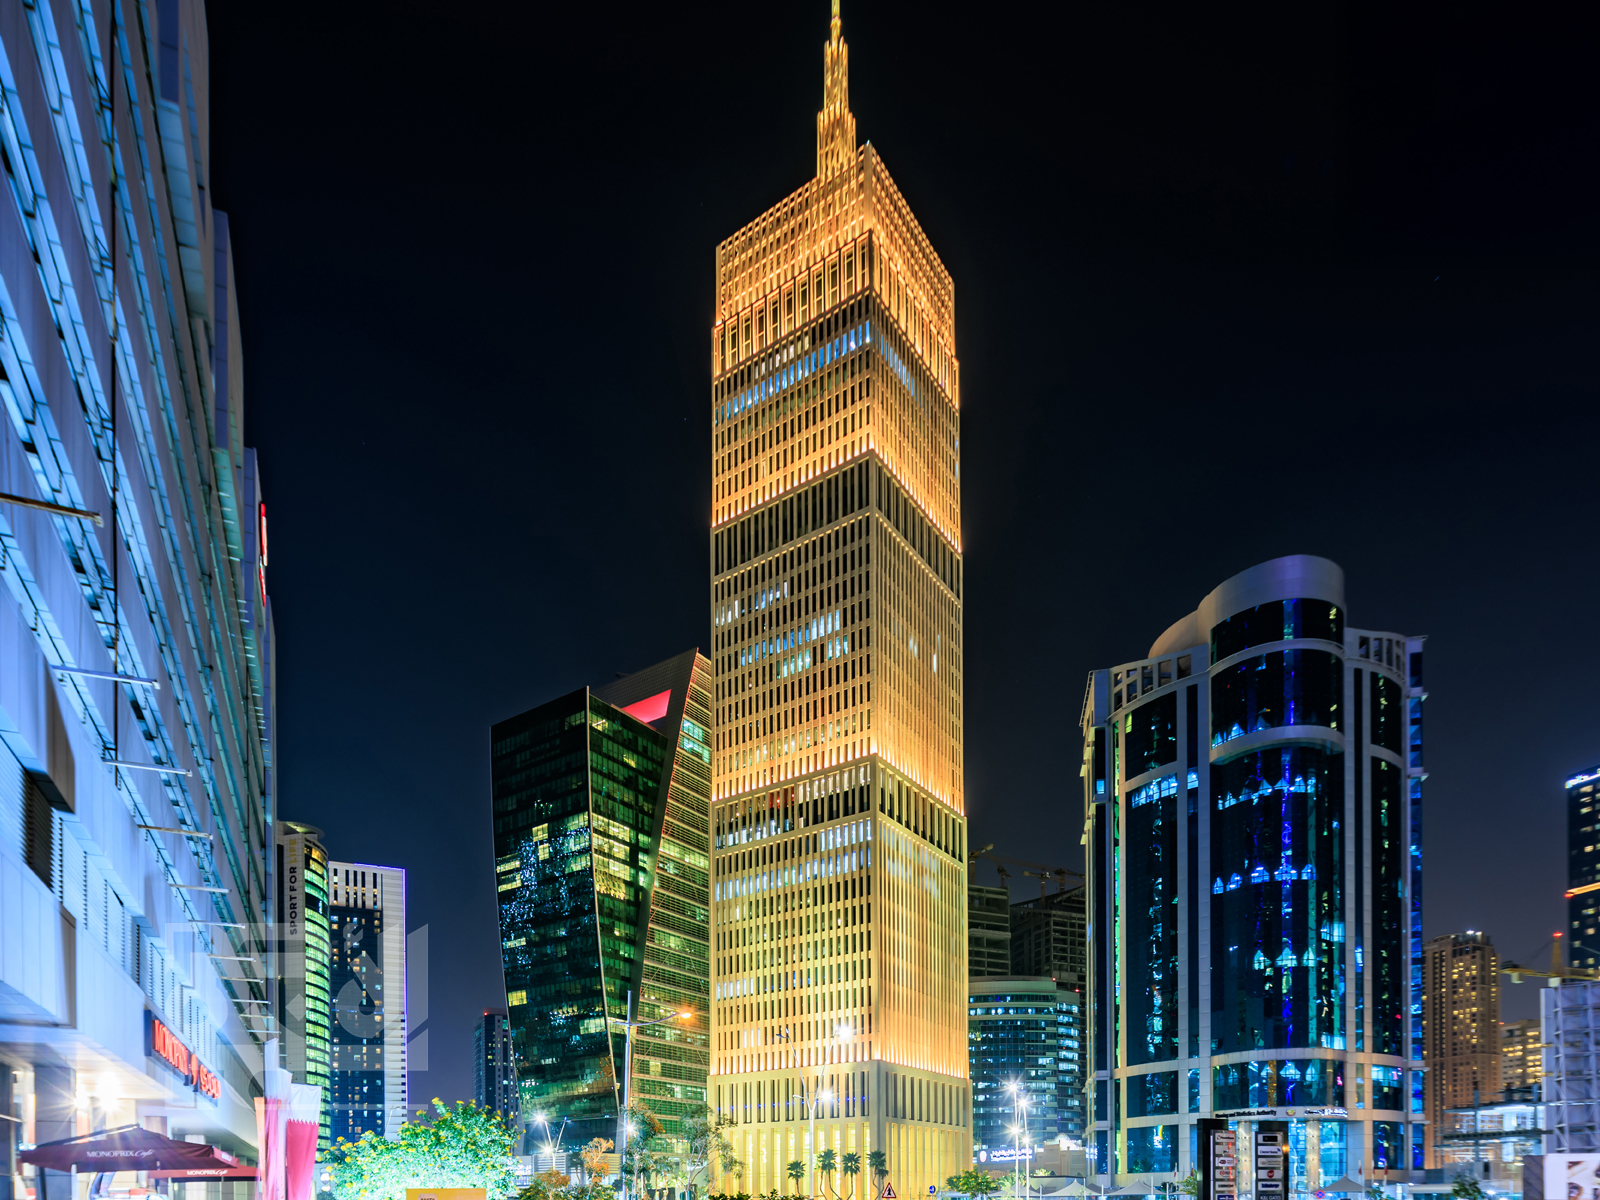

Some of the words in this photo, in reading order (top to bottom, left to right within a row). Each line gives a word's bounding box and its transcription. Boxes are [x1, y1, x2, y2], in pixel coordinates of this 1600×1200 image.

[288, 838, 297, 864] LIFE
[289, 866, 298, 892] FOR
[289, 895, 298, 935] SPORT
[1256, 1109, 1277, 1117] Authority
[86, 1149, 134, 1158] MONOPRIX
[134, 1148, 156, 1159] Café
